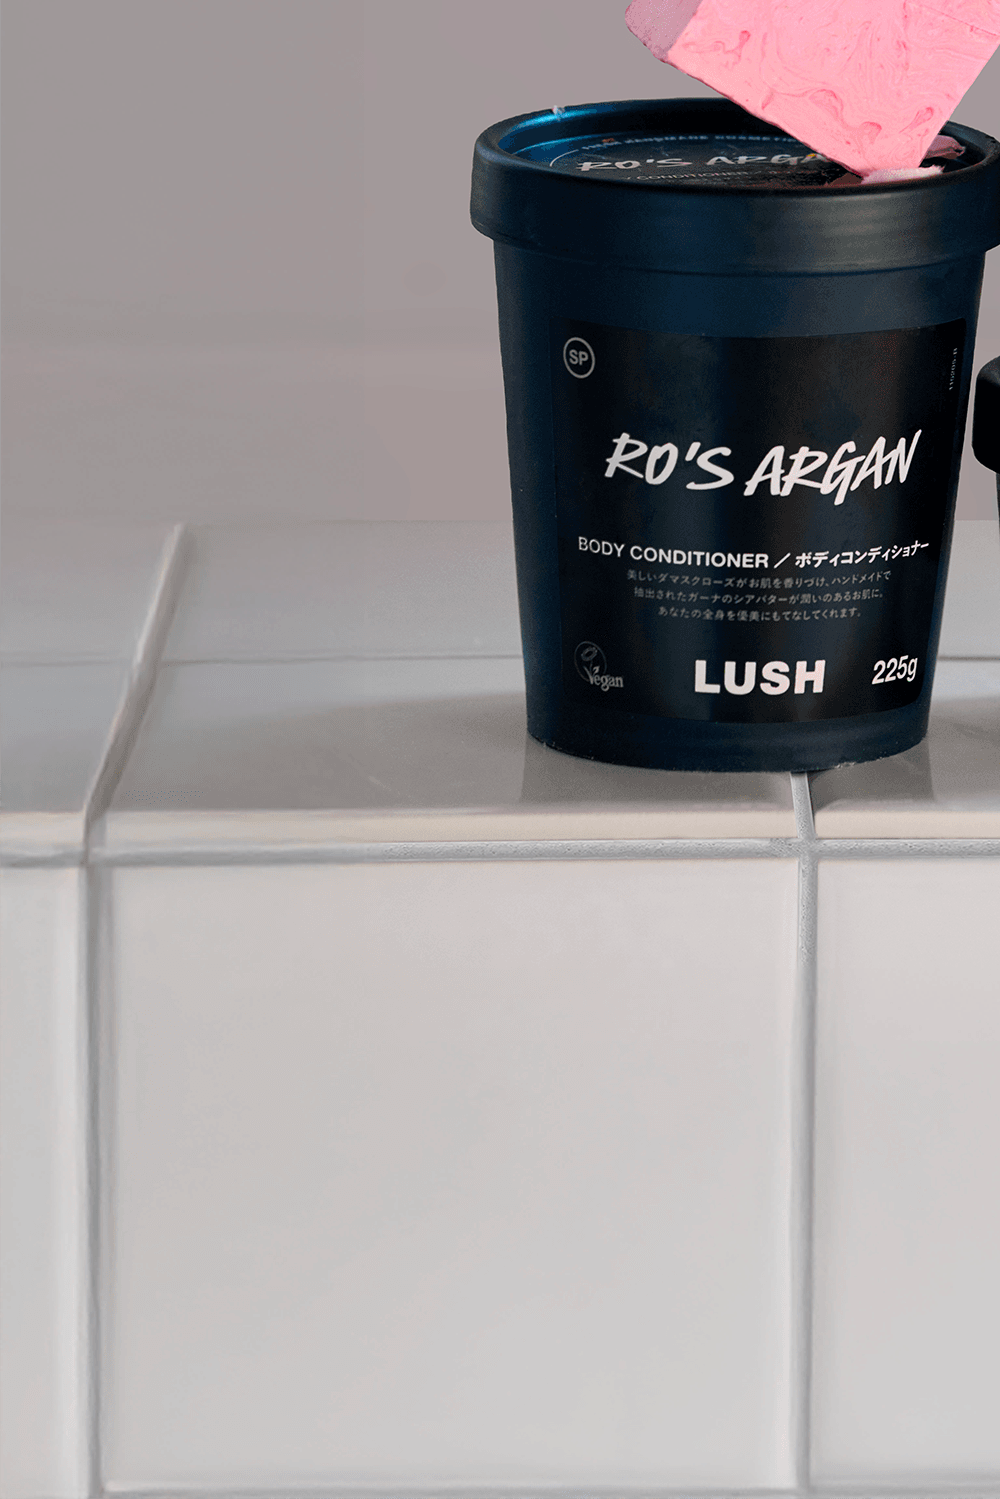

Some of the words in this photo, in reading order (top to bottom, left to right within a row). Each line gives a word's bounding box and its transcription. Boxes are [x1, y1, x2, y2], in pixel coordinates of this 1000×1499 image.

[576, 158, 693, 171] RO'S
[706, 152, 832, 166] ARGA
[604, 432, 735, 491] RO'S
[743, 429, 923, 506] ARGAN
[577, 536, 625, 558] BODY
[630, 545, 769, 569] CONDITIONER
[795, 540, 930, 568] ボディコンディショナー
[583, 666, 625, 692] Vegan
[694, 660, 826, 695] LUSH
[872, 655, 918, 684] 225g
